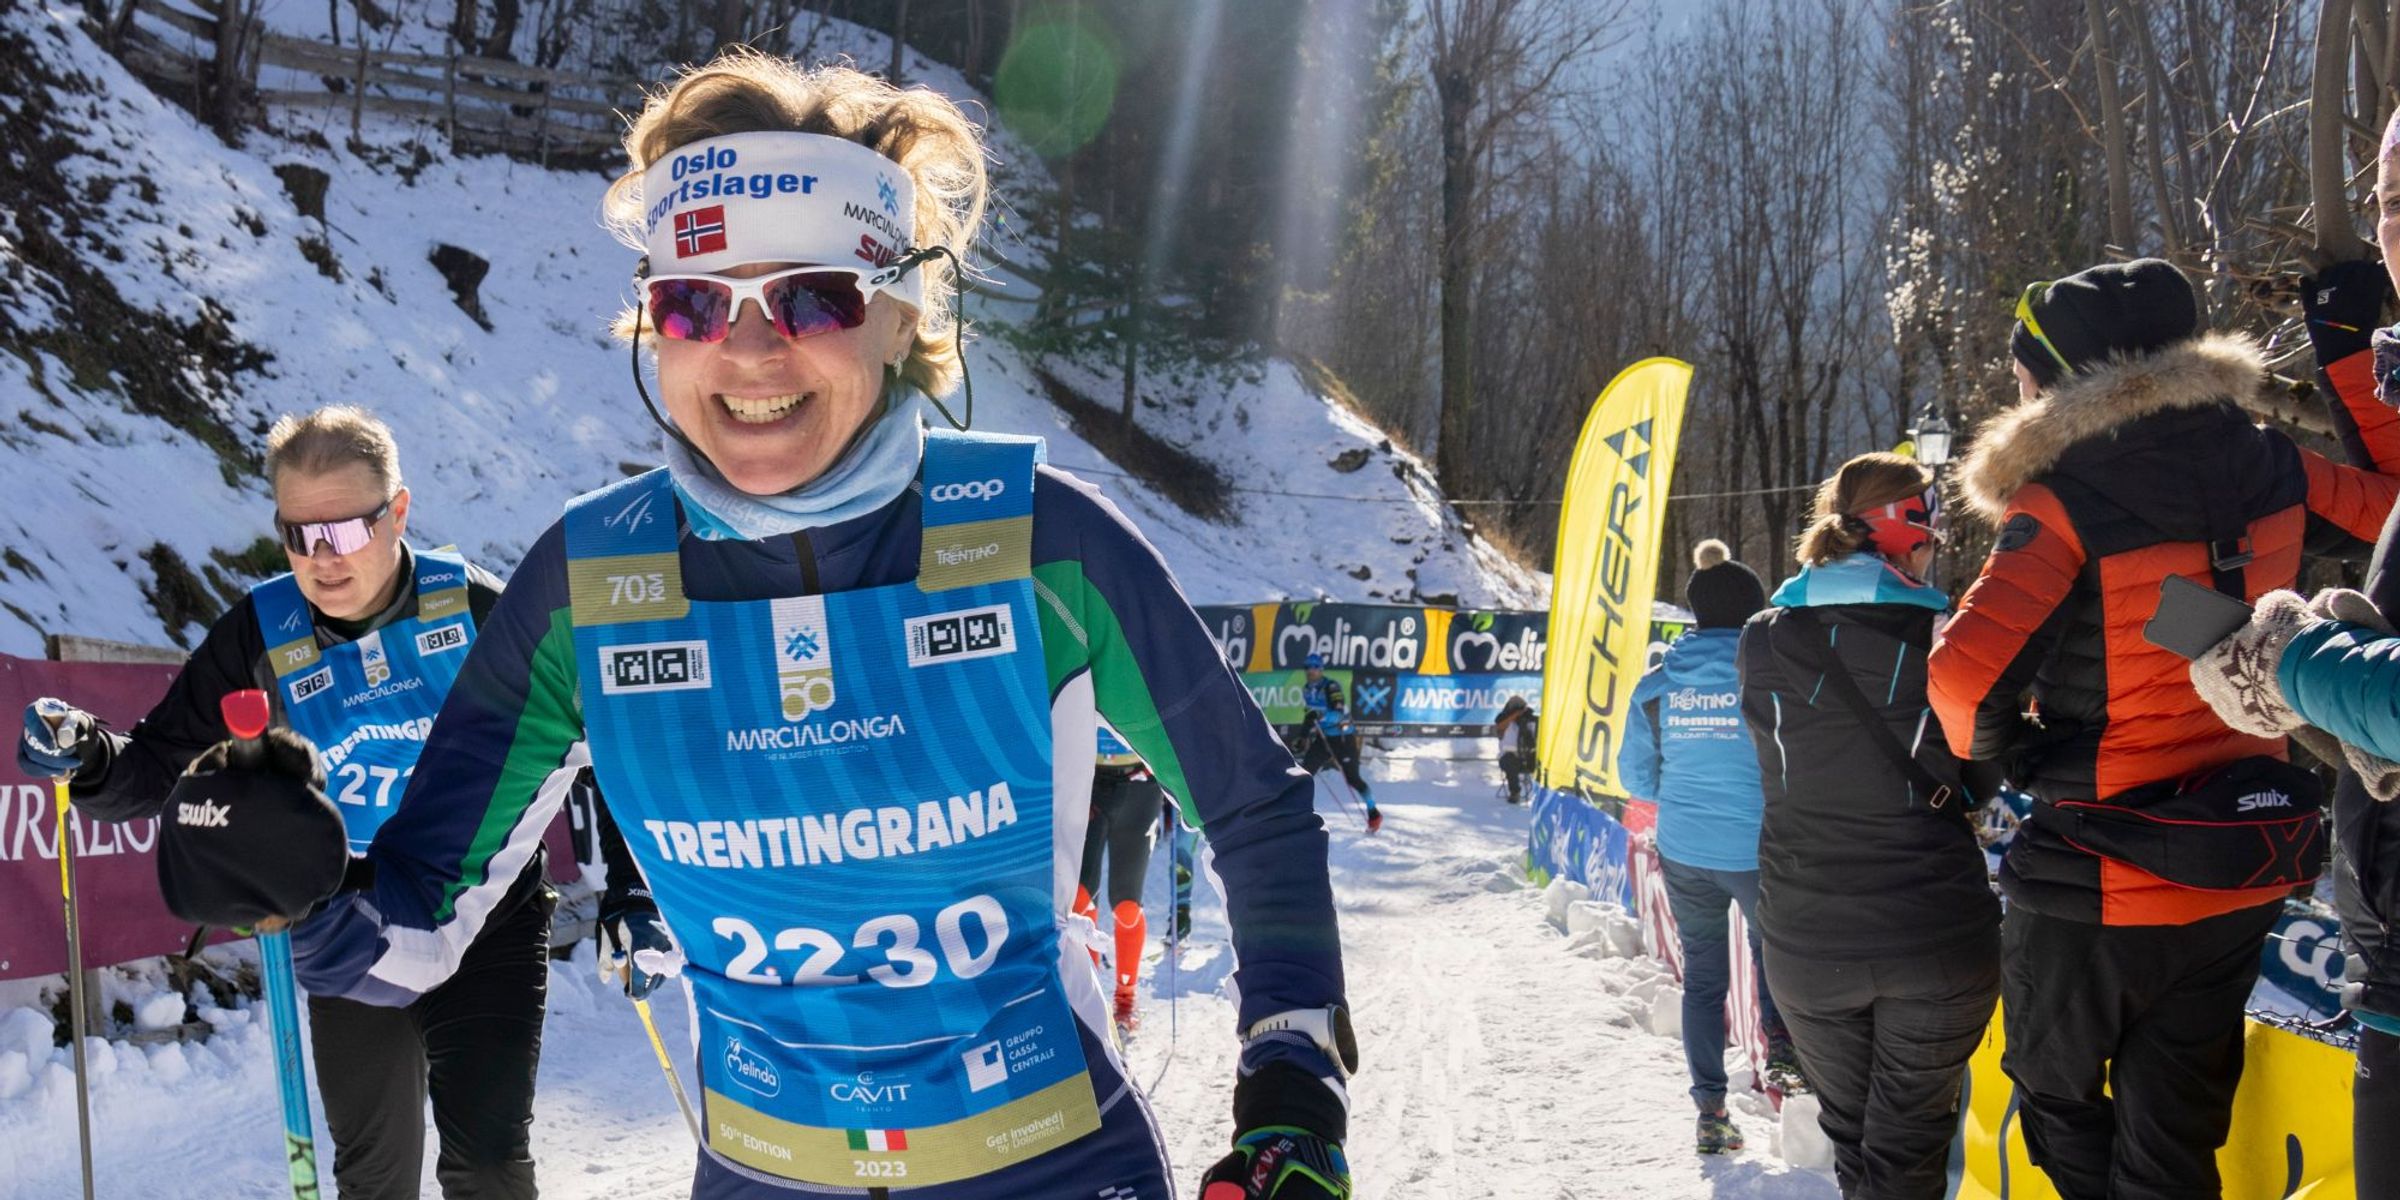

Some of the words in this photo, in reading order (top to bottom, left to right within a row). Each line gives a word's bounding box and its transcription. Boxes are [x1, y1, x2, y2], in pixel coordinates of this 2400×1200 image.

[671, 146, 737, 182] Oslo
[930, 478, 1005, 502] coop
[419, 573, 453, 585] coop
[606, 575, 646, 606] 70
[285, 648, 302, 665] 70
[343, 676, 424, 708] MARCIALONGA
[778, 674, 836, 723] 50
[1667, 690, 1738, 711] TRENTINO
[319, 712, 438, 772] TRENTINGR
[726, 714, 906, 751] MARCIALONGA
[337, 762, 415, 807] 27
[643, 781, 1018, 869] TRENTINGRANA
[711, 893, 1010, 988] 2230
[1006, 1025, 1043, 1048] GRUPPO
[1009, 1042, 1038, 1061] CASSA
[1012, 1048, 1056, 1073] CENTRALE
[727, 1053, 777, 1087] Melinda
[830, 1083, 912, 1104] CAVIT
[744, 1134, 792, 1161] EDITION
[986, 1132, 1009, 1148] Get
[853, 1160, 908, 1178] 2023
